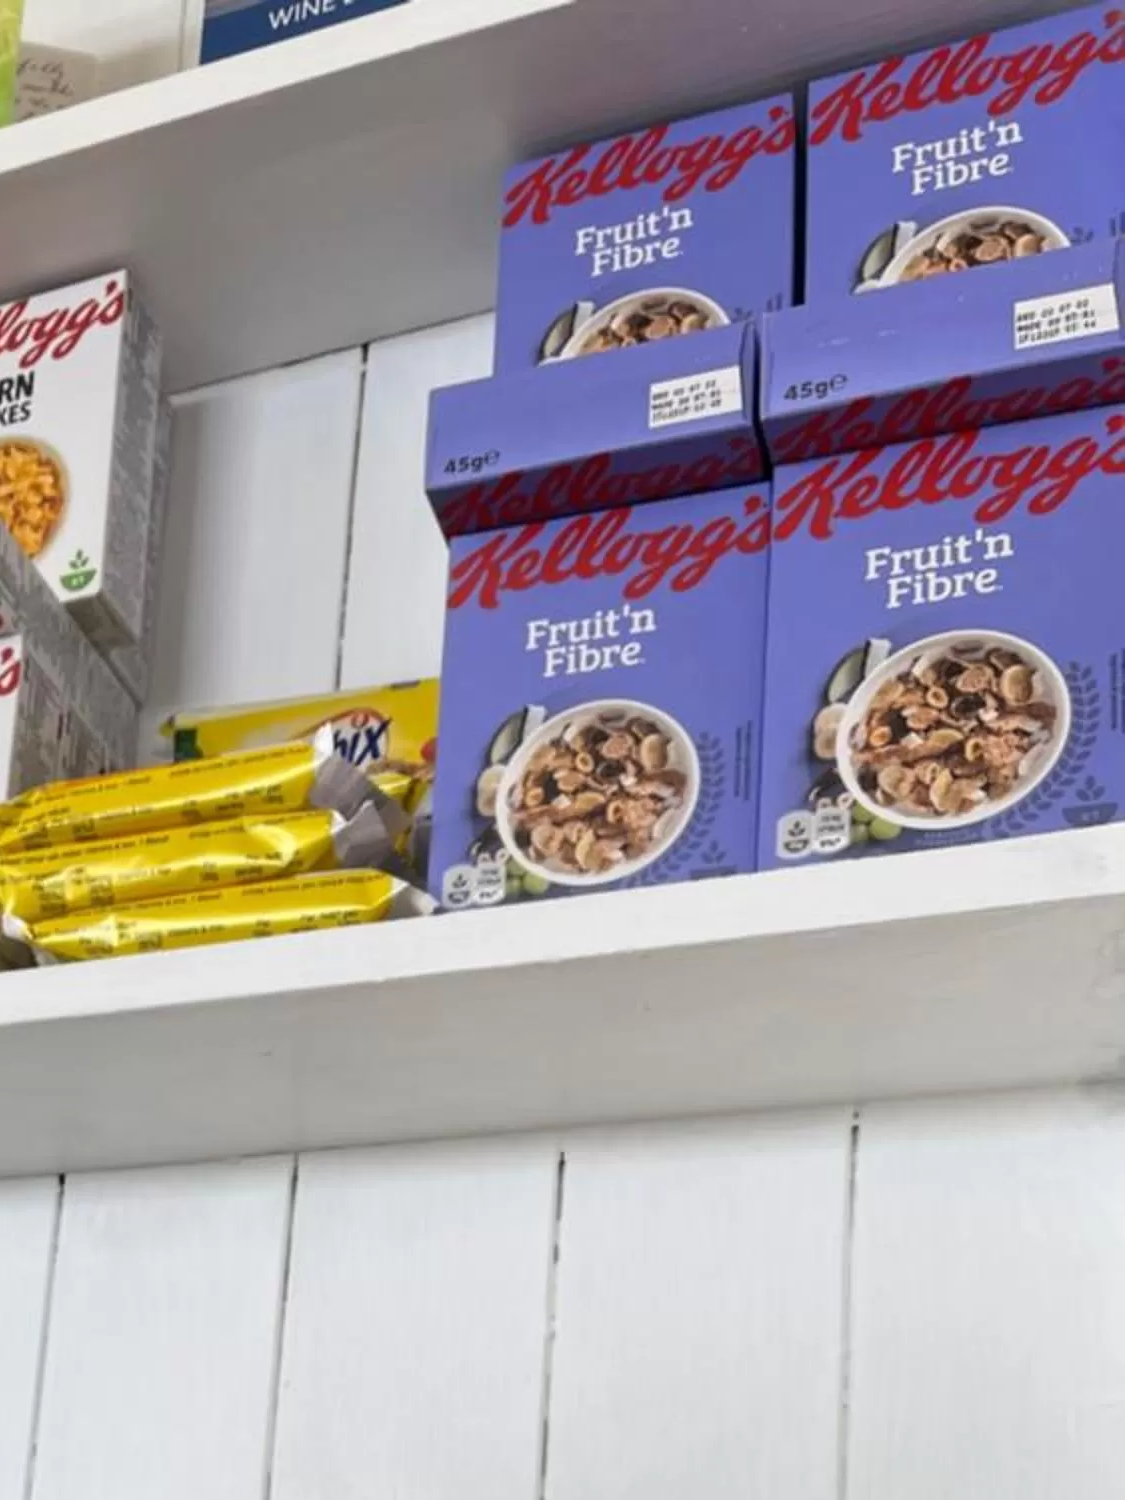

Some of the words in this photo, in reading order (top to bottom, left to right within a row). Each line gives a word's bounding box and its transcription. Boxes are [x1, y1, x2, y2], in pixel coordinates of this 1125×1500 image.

[268, 0, 337, 30] WINE
[809, 9, 1125, 145] Kellogg's
[502, 105, 796, 228] Kellogg's
[911, 153, 1011, 196] Fibre
[591, 236, 681, 278] Fibre
[775, 413, 1125, 542] Kellogg's
[448, 495, 772, 609] Kellogg's
[885, 566, 998, 609] Fibre
[543, 639, 641, 679] Fibre
